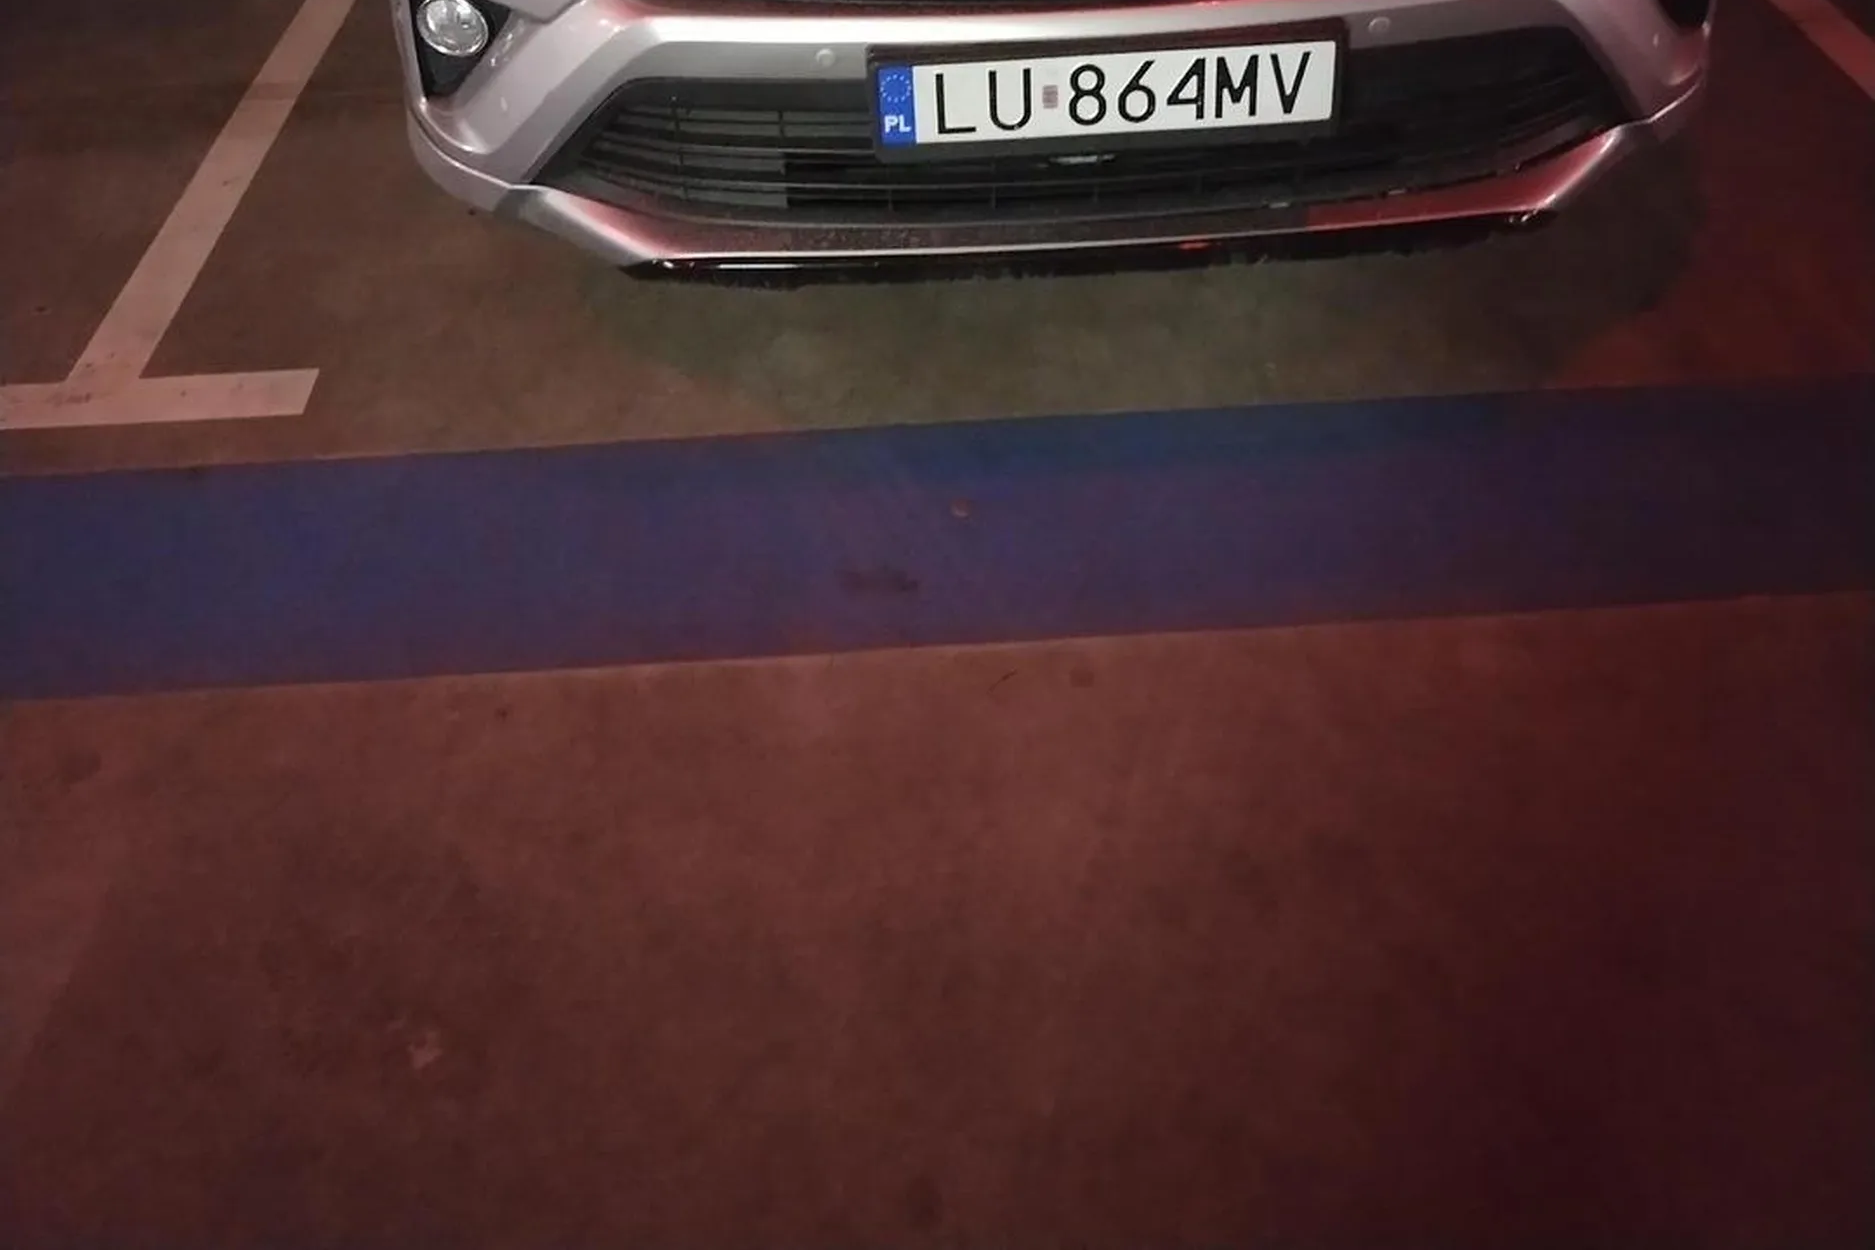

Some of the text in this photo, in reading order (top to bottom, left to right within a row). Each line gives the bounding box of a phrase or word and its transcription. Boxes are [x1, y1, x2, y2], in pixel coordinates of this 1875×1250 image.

[935, 51, 1312, 135] LU 864MV
[884, 114, 912, 133] PL
